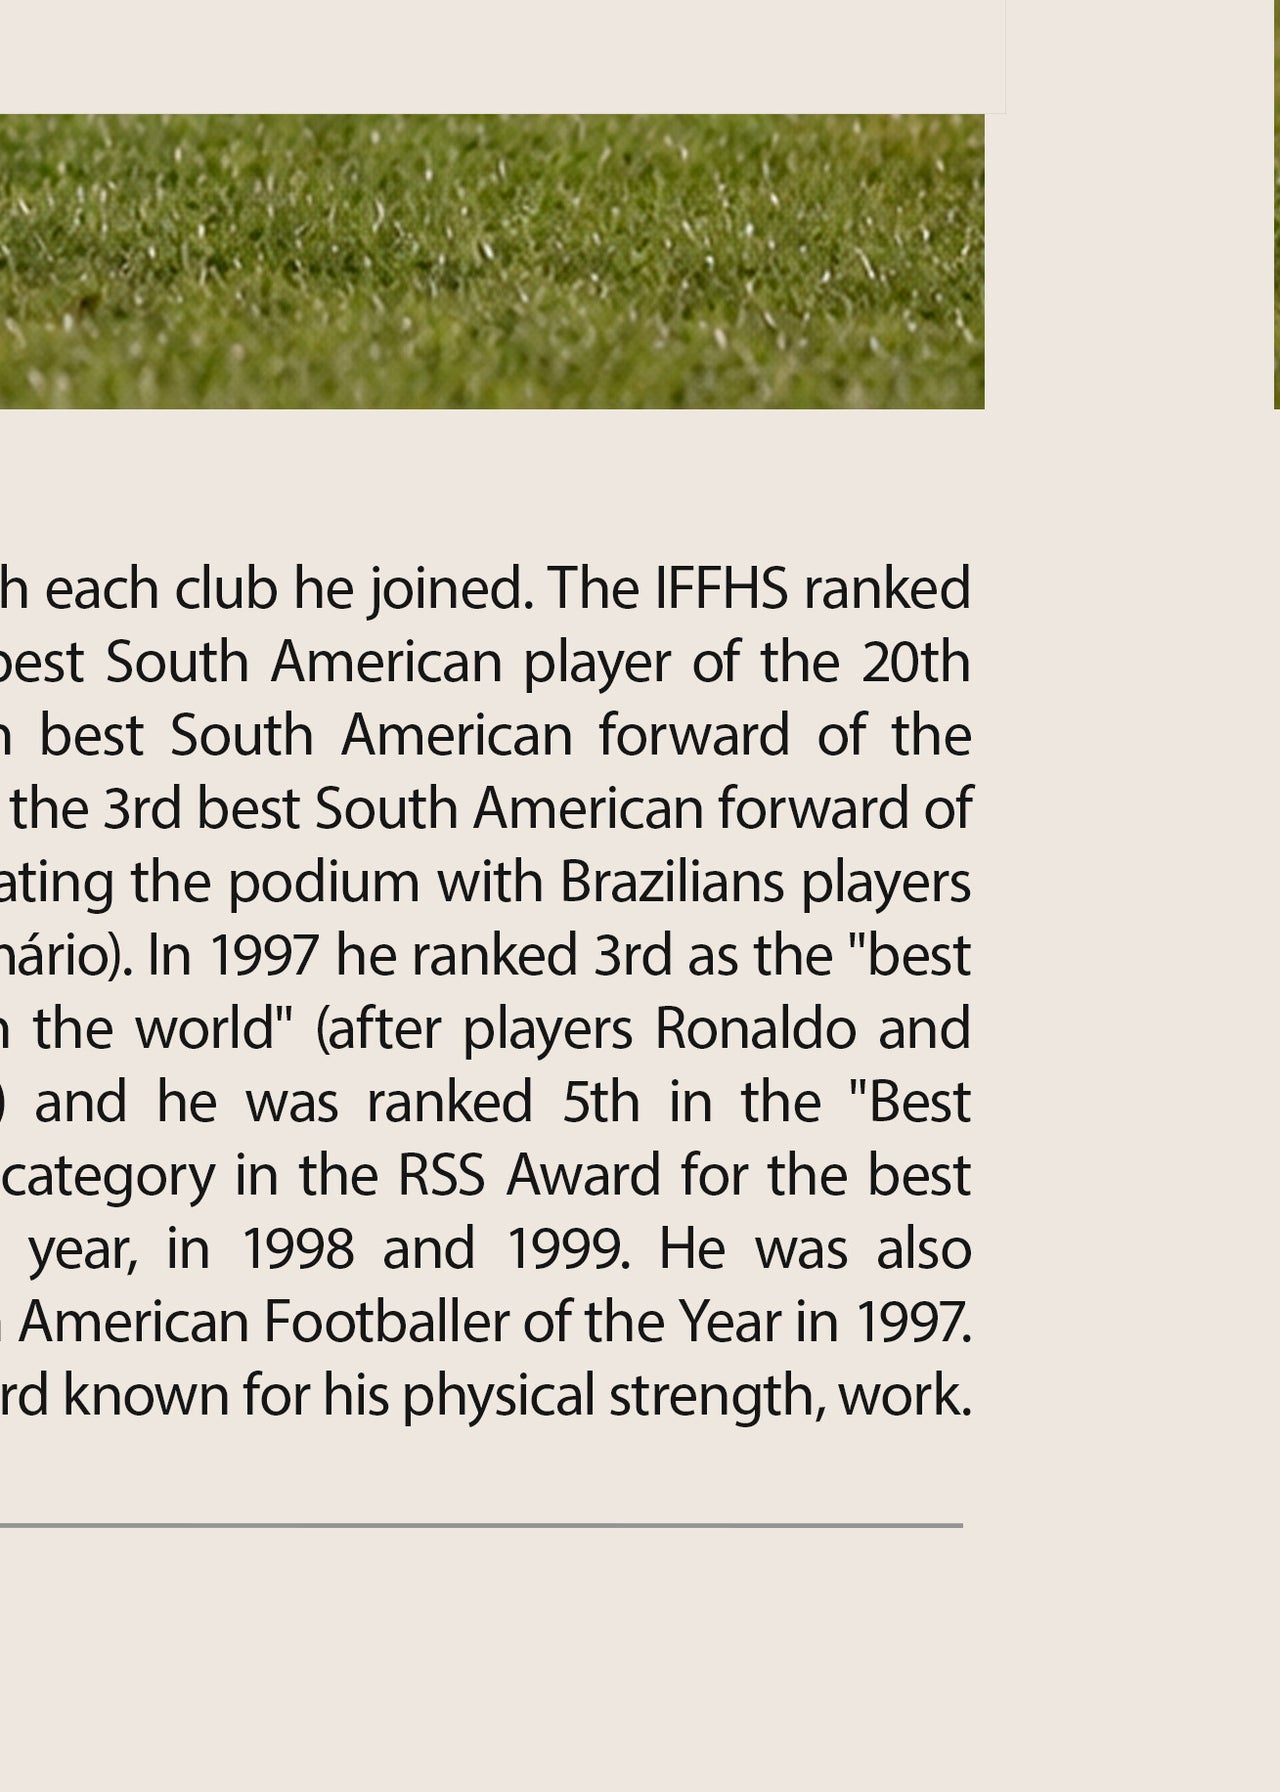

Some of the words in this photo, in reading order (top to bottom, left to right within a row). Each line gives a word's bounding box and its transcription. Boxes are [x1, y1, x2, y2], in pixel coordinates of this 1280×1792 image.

[46, 563, 158, 610] each
[176, 563, 278, 610] club
[296, 563, 354, 610] he
[366, 563, 533, 622] joined.
[546, 563, 639, 610] The
[658, 565, 788, 610] IFFHS
[806, 563, 970, 610] ranked
[41, 710, 144, 756] best
[171, 710, 312, 756] South
[340, 712, 571, 756] American
[598, 710, 789, 756] forward
[818, 710, 869, 756] of
[891, 710, 972, 756] the
[130, 856, 211, 903] the
[230, 856, 418, 914] podium
[437, 856, 542, 903] with
[563, 856, 784, 903] Brazilians
[803, 856, 971, 915] players
[32, 1003, 113, 1050] the
[134, 1003, 292, 1050] world"
[317, 1003, 442, 1056] (after
[465, 1003, 633, 1061] players
[658, 1003, 857, 1050] Ronaldo
[879, 1003, 969, 1050] and
[2, 1155, 217, 1208] category
[237, 1152, 277, 1196] in
[298, 1150, 378, 1196] the
[401, 1152, 485, 1196] RSS
[506, 1150, 660, 1196] Award
[680, 1150, 749, 1196] for
[767, 1150, 848, 1196] the
[870, 1150, 972, 1196] best
[27, 1237, 137, 1281] year,
[168, 1225, 209, 1269] in
[244, 1227, 354, 1270] 1998
[383, 1223, 474, 1270] and
[509, 1227, 630, 1270] 1999.
[662, 1225, 726, 1270] He
[754, 1237, 848, 1270] was
[877, 1223, 972, 1270] also
[65, 1370, 228, 1416] known
[242, 1370, 311, 1416] for
[325, 1370, 389, 1416] his
[404, 1370, 594, 1428] physical
[610, 1370, 826, 1428] strength,
[837, 1370, 971, 1417] work.
